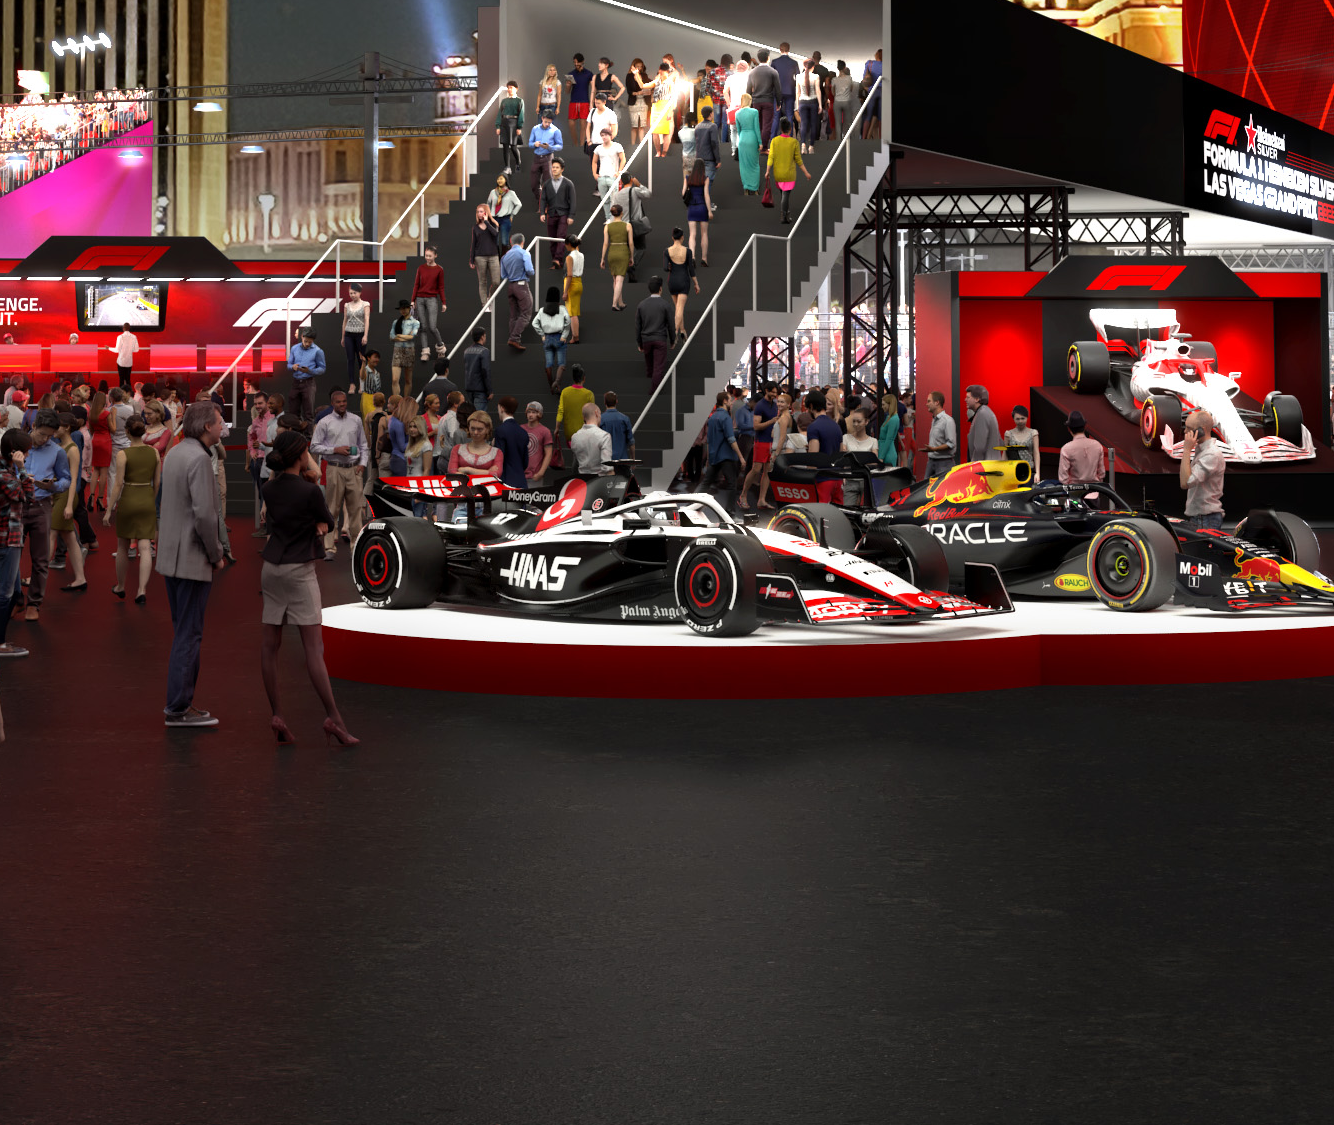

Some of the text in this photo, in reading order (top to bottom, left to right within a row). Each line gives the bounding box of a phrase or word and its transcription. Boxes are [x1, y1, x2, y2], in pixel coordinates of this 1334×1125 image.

[1257, 144, 1278, 160] SILVER
[1203, 140, 1257, 180] FORMULA
[1258, 158, 1265, 181] 1
[1265, 160, 1309, 194] HEINEKEN
[1204, 169, 1227, 197] LAS
[1228, 175, 1263, 206] VEGAS
[1264, 186, 1297, 215] GRAND
[1297, 195, 1318, 220] PRIX
[508, 491, 556, 504] MoneyGram
[776, 486, 809, 500] ESSO
[921, 522, 1028, 544] RACLE
[1113, 524, 1136, 536] ZERO
[500, 552, 581, 591] HAAS
[1180, 562, 1212, 576] Mobil
[620, 605, 651, 619] Palm
[687, 619, 714, 632] ZERO
